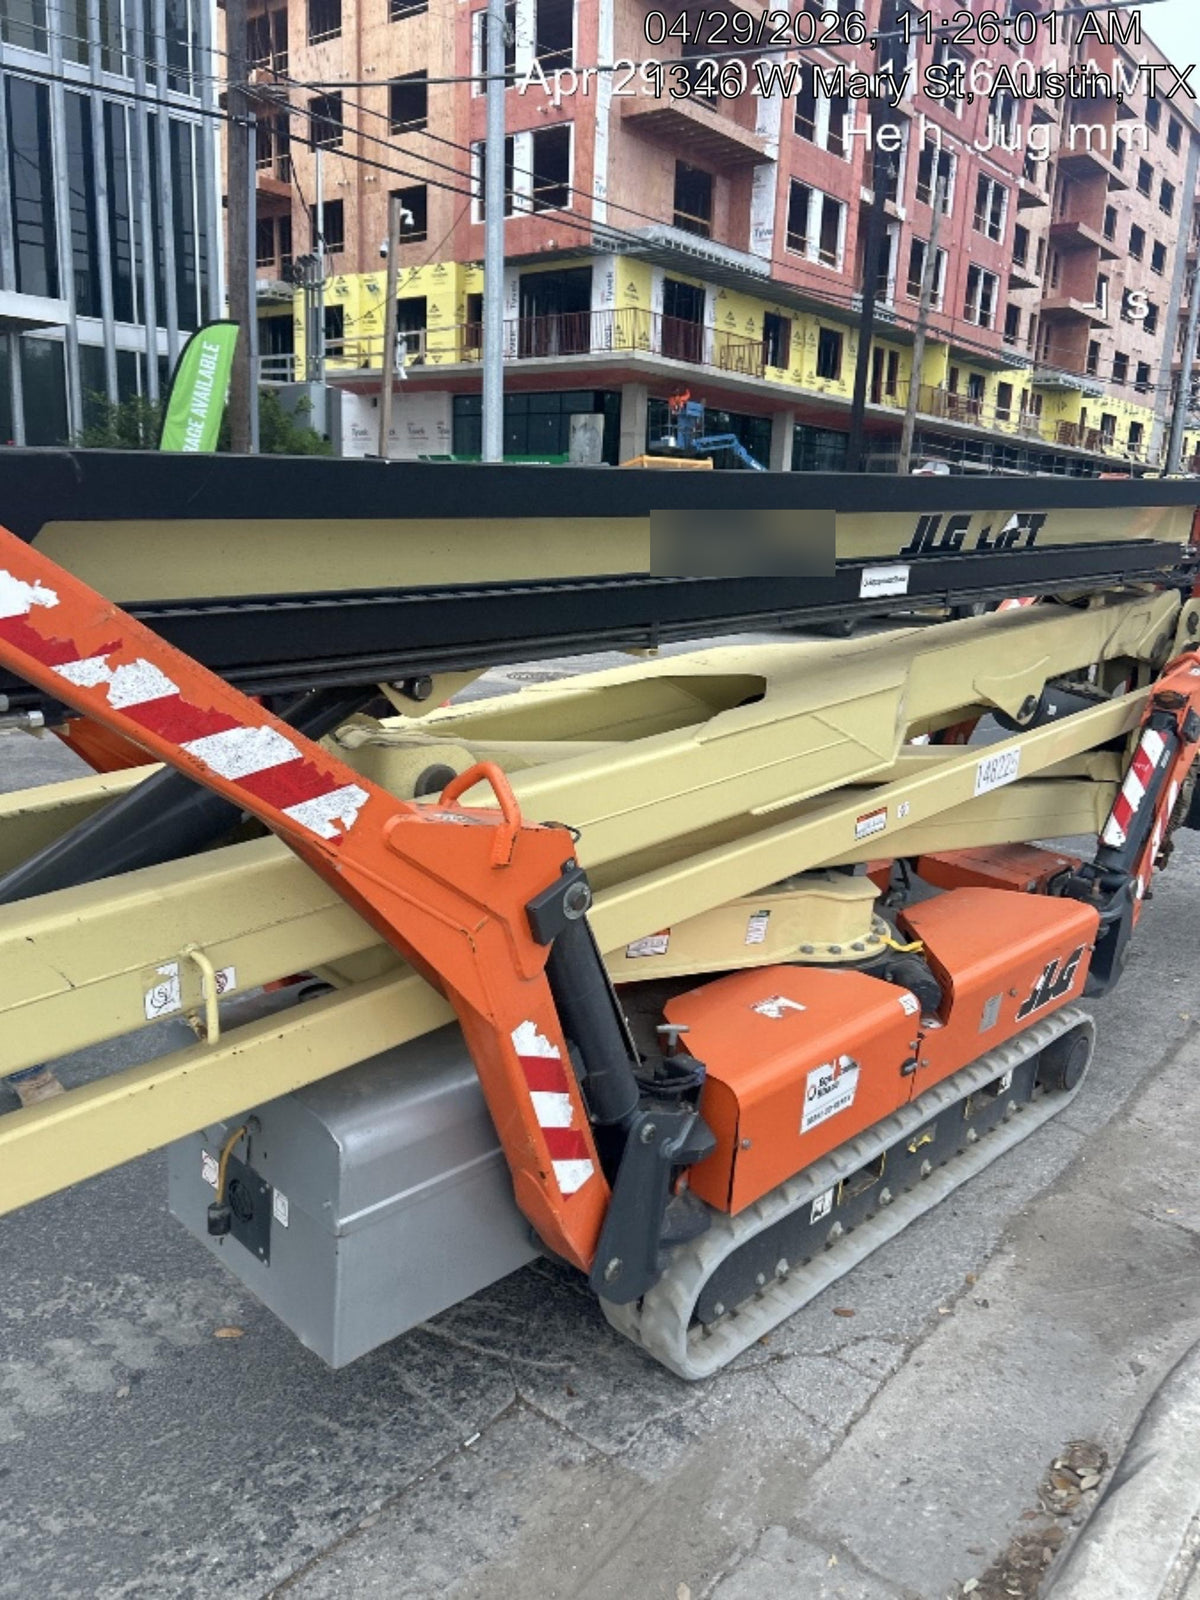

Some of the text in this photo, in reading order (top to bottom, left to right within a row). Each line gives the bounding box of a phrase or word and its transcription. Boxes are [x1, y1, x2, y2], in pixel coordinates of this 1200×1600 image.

[190, 341, 220, 418] AVAILABLE
[900, 513, 974, 556] JLG
[1014, 942, 1087, 1023] JLG
